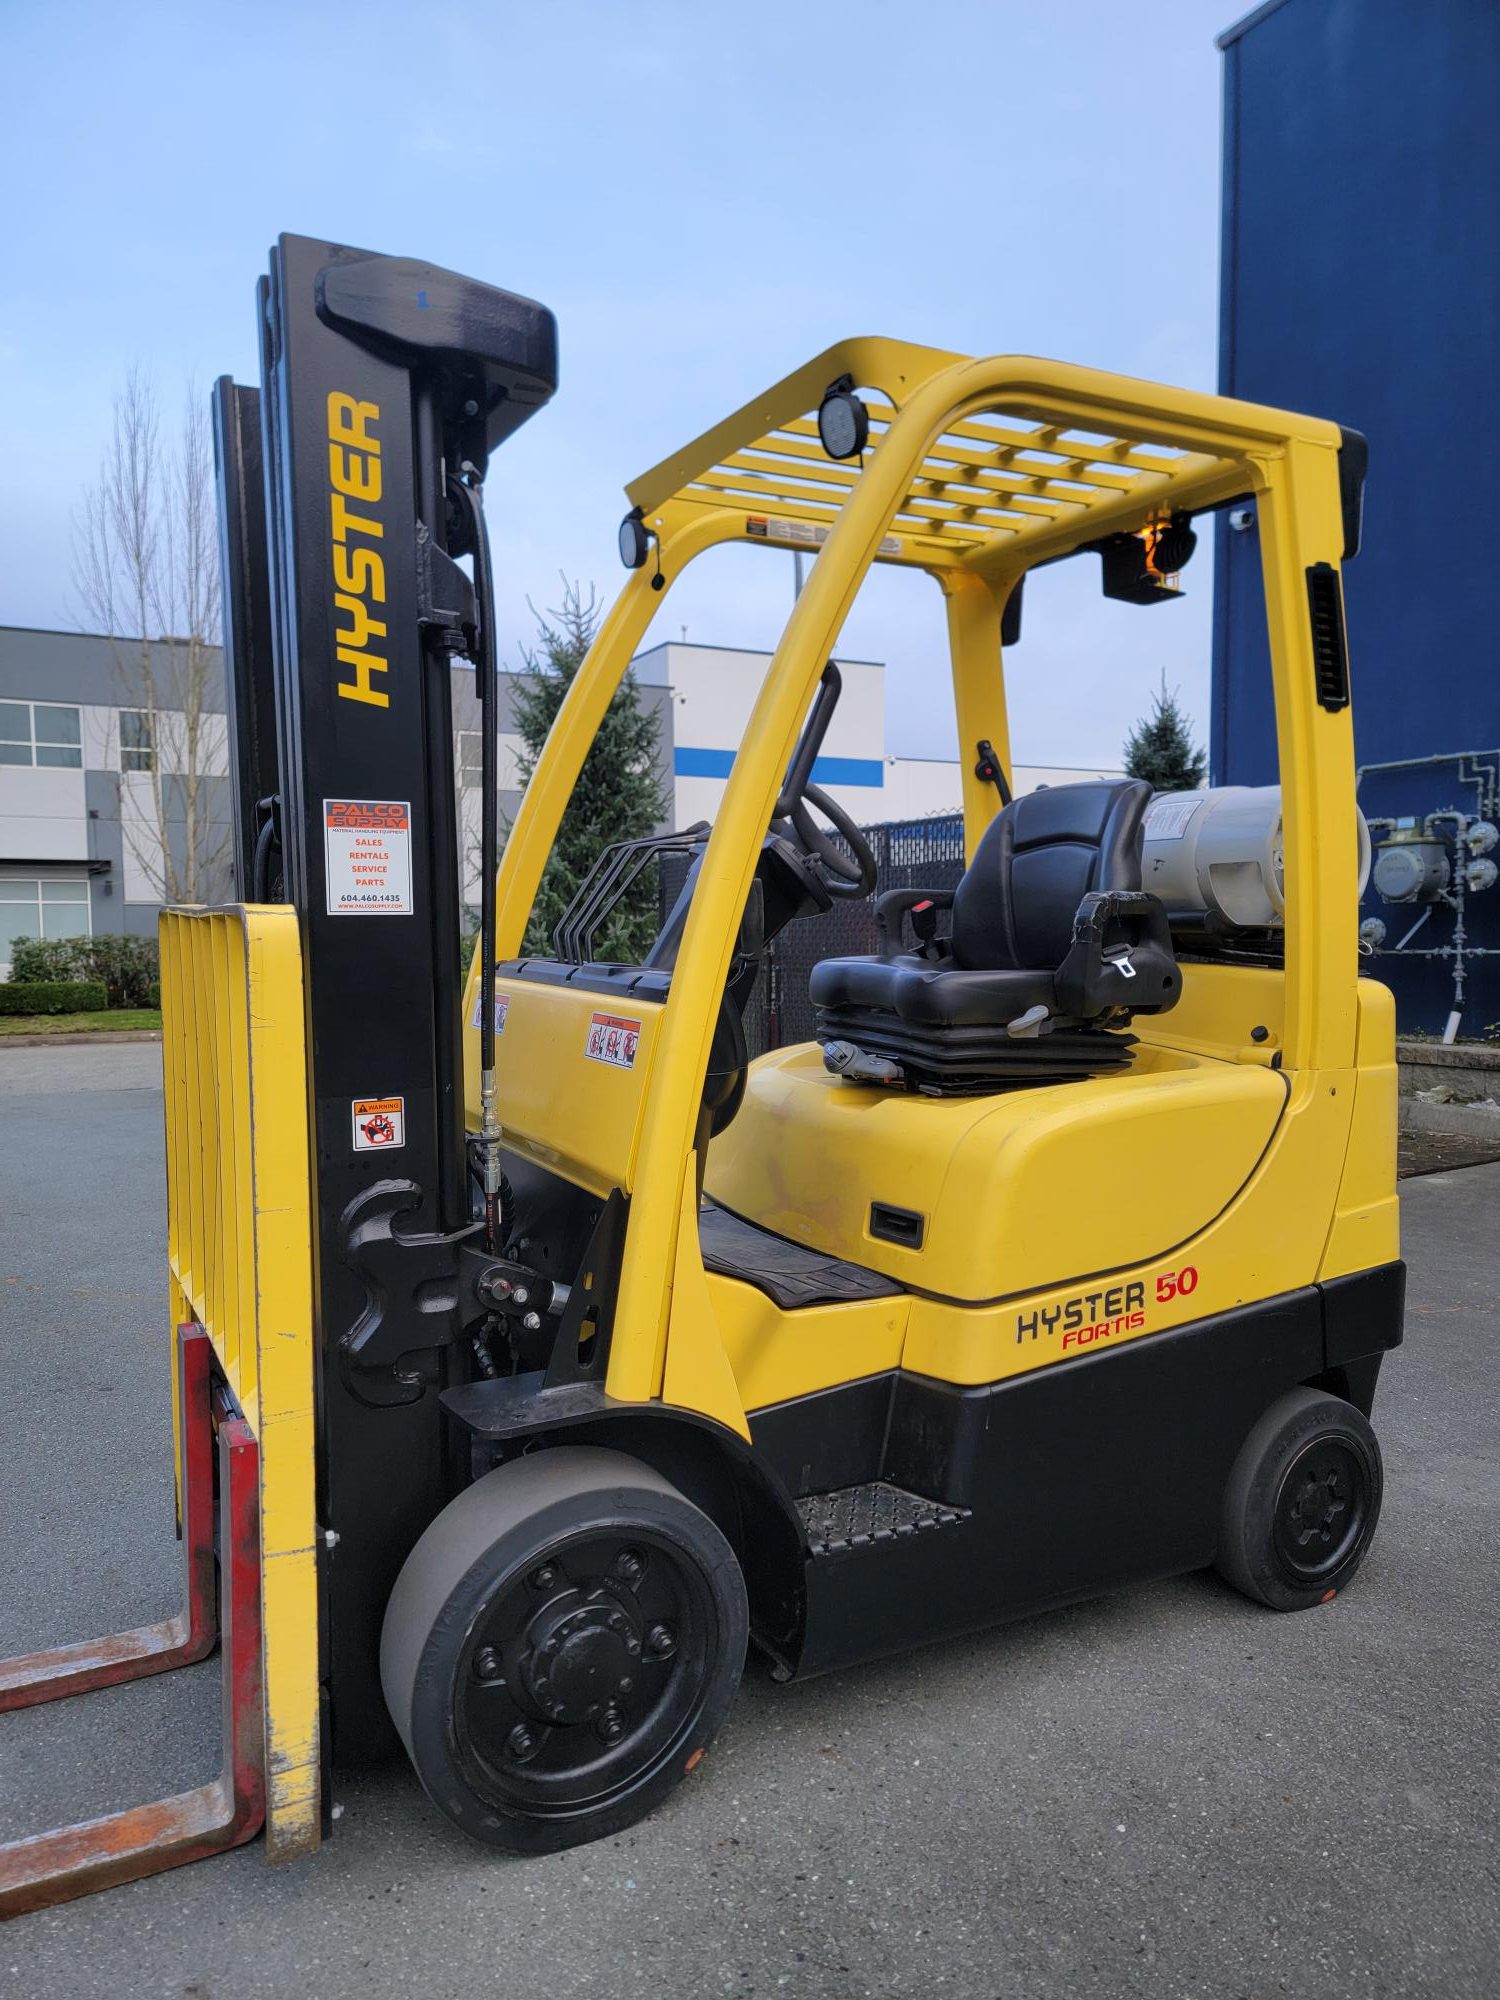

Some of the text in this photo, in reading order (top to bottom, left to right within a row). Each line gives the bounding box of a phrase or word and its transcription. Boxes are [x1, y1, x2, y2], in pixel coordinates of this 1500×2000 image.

[327, 391, 389, 708] HYSTER
[332, 803, 405, 817] PALCO
[333, 817, 404, 829] SUPPLY
[355, 839, 383, 847] SALES
[349, 852, 389, 860] RENTALS
[351, 865, 388, 873] SERVICE
[355, 879, 385, 887] PARTS
[340, 894, 401, 902] 604.460.1435
[368, 1103, 399, 1111] WARNING
[1017, 1265, 1198, 1344] HYSTER 50
[1062, 1311, 1145, 1350] FORTIS
